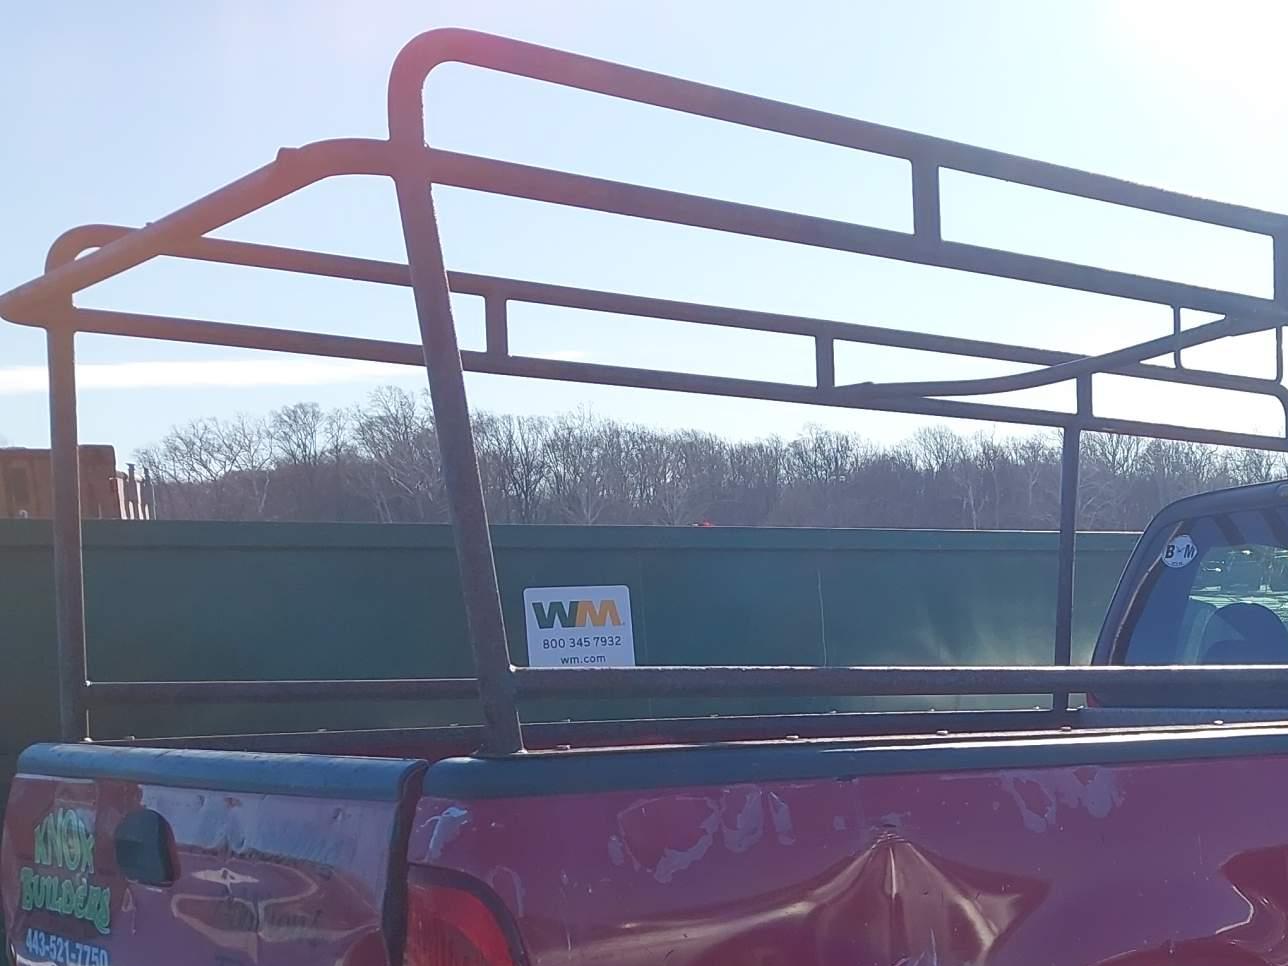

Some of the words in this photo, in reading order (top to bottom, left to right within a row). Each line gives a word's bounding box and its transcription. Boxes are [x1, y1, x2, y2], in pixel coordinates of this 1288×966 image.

[532, 599, 621, 629] WM
[542, 638, 566, 650] 800
[569, 636, 590, 649] 345
[593, 635, 622, 648] 7932
[560, 654, 606, 665] wm.com
[34, 807, 95, 874] KNOX
